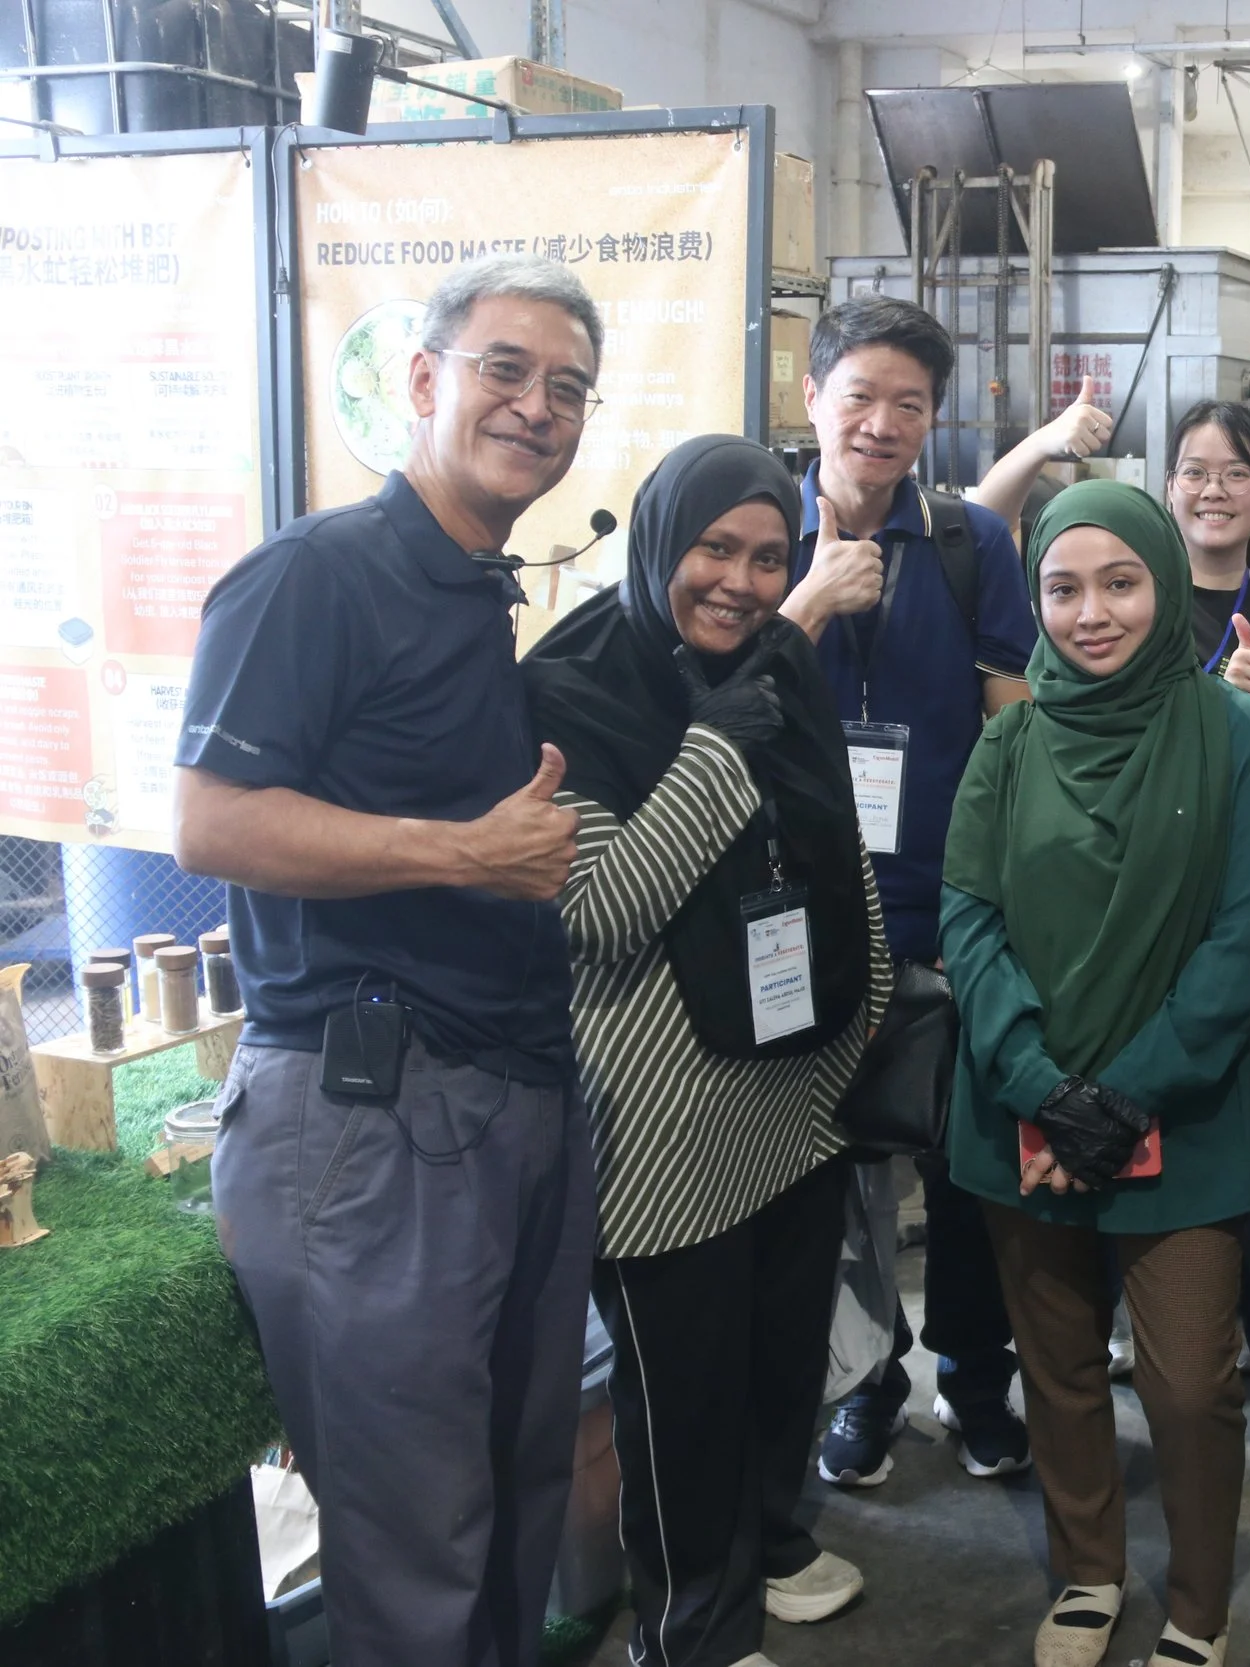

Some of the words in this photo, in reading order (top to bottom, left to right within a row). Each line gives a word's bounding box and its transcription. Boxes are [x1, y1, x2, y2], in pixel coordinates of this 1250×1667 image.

[316, 201, 356, 224] HOW
[361, 201, 381, 223] TO
[0, 224, 86, 251] POSTING
[141, 222, 178, 248] BSF
[317, 242, 396, 266] REDUCE
[401, 240, 455, 264] FOOD
[646, 372, 676, 384] can
[856, 802, 888, 811] ICIPANT
[760, 974, 803, 993] PARTICIPANT
